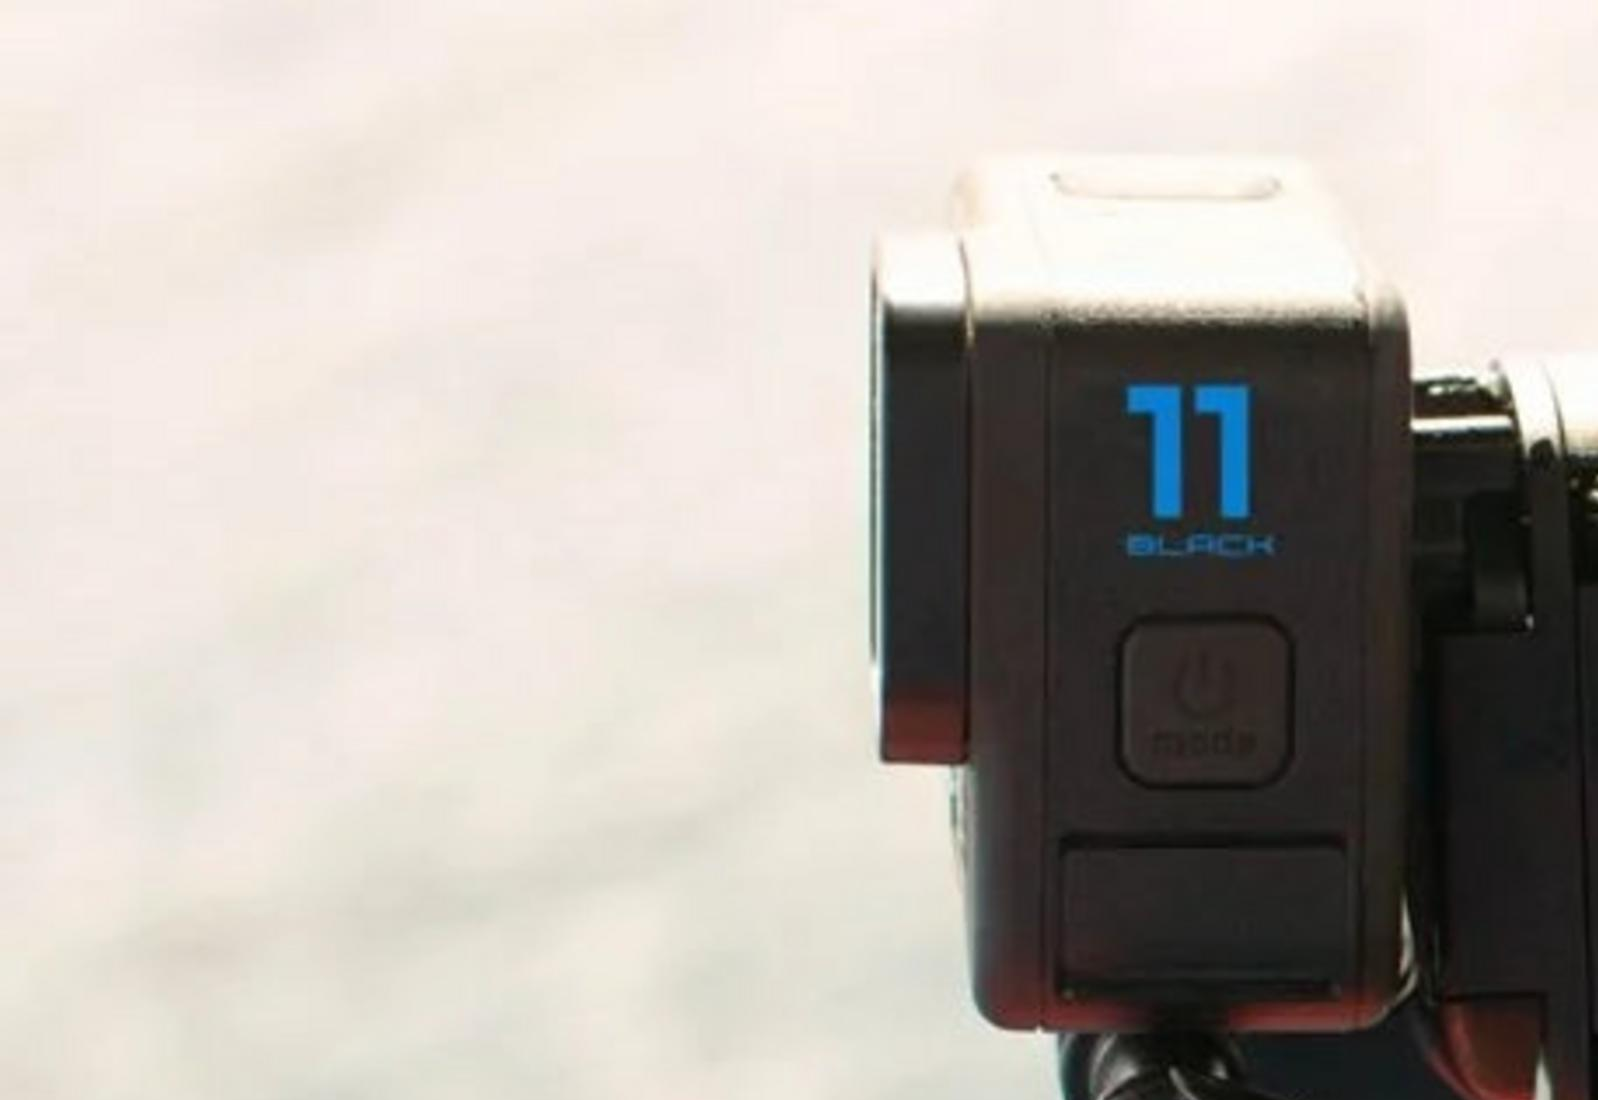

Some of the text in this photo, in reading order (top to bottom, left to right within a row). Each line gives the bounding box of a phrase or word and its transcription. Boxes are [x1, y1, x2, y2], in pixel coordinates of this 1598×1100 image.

[1126, 383, 1251, 520] 11
[1126, 533, 1275, 557] BLACK
[1152, 726, 1258, 757] mode
